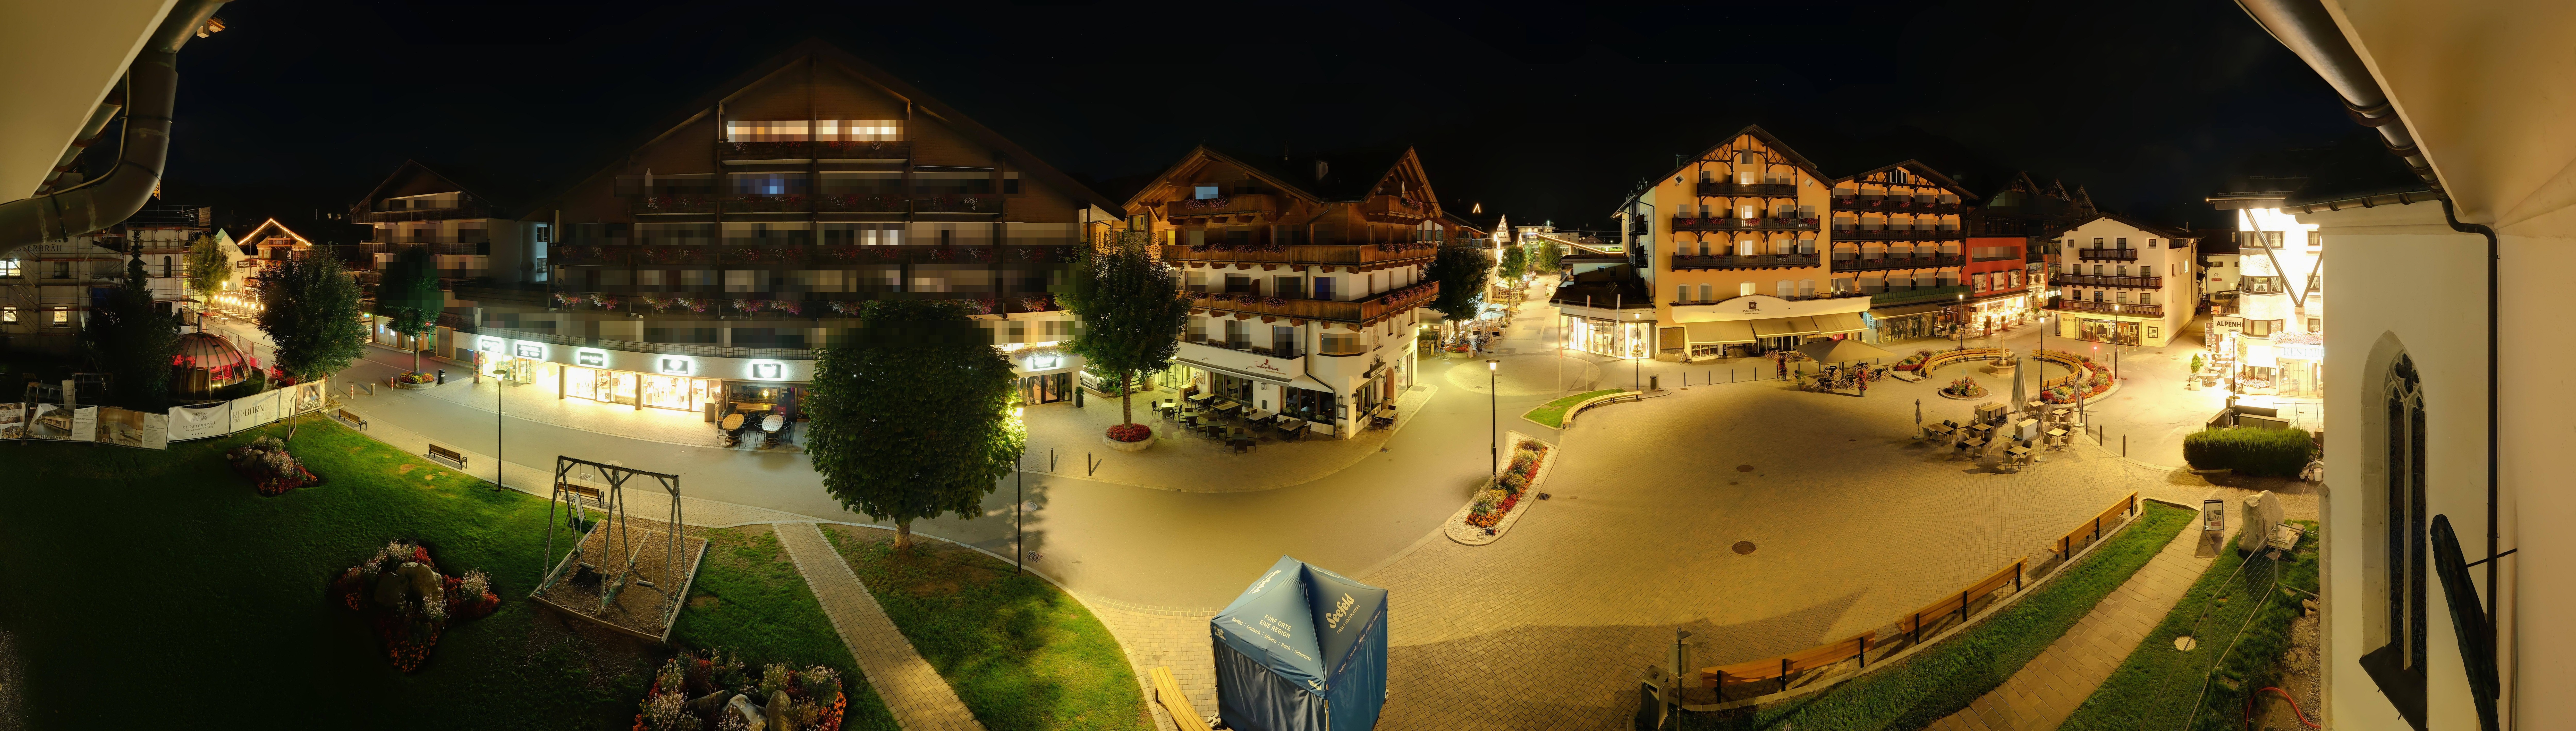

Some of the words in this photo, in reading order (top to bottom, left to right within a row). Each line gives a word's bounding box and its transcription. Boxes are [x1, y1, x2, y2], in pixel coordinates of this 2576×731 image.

[1402, 343, 1410, 351] SAILER
[1371, 364, 1385, 377] RESTAURANT
[1326, 592, 1354, 629] Seefeld
[1336, 623, 1346, 635] TIROLS
[1345, 604, 1360, 624] HOCHPLATEAU
[1259, 619, 1271, 629] EINE
[1271, 625, 1291, 639] REGION
[1264, 614, 1278, 624] FÜNF
[1278, 621, 1292, 631] ORTE
[1232, 617, 1243, 626] Seefeld
[1246, 624, 1260, 635] Leutasch
[1264, 634, 1277, 644] Mösern
[1281, 642, 1291, 651] Reith
[1294, 650, 1311, 661] Scharnitz
